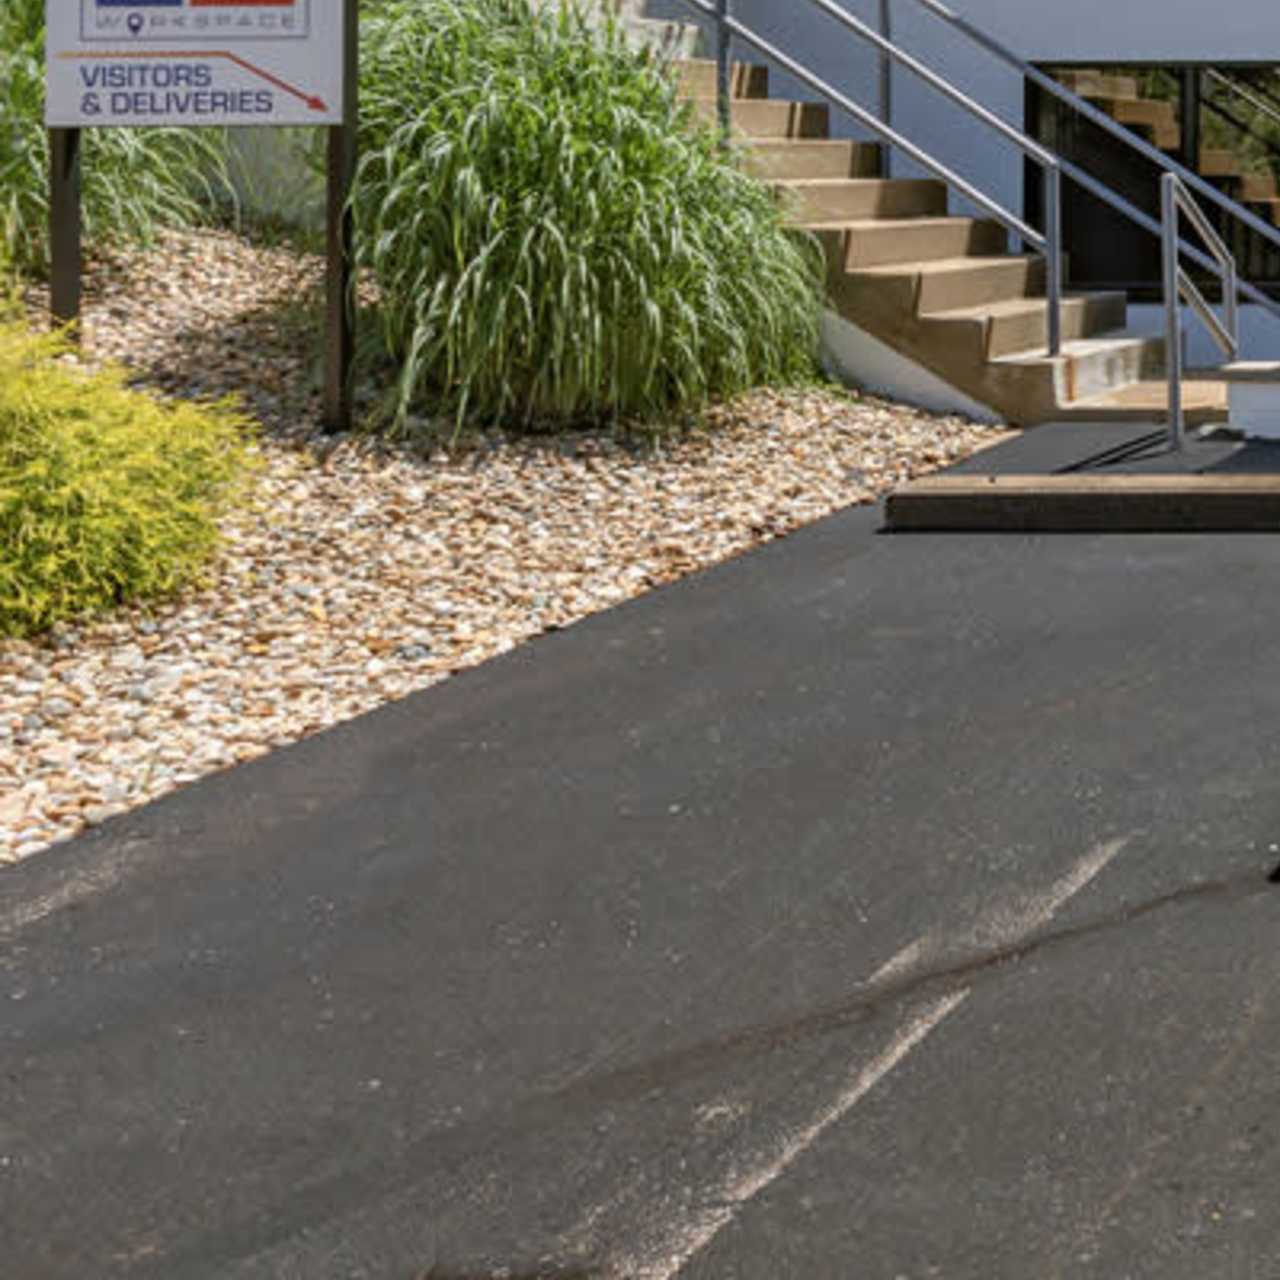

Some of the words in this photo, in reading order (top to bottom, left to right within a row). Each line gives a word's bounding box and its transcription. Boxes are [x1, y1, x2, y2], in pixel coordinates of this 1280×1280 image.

[80, 65, 212, 88] VISITORS
[80, 92, 101, 115] &
[111, 91, 273, 114] DELIVERIES
